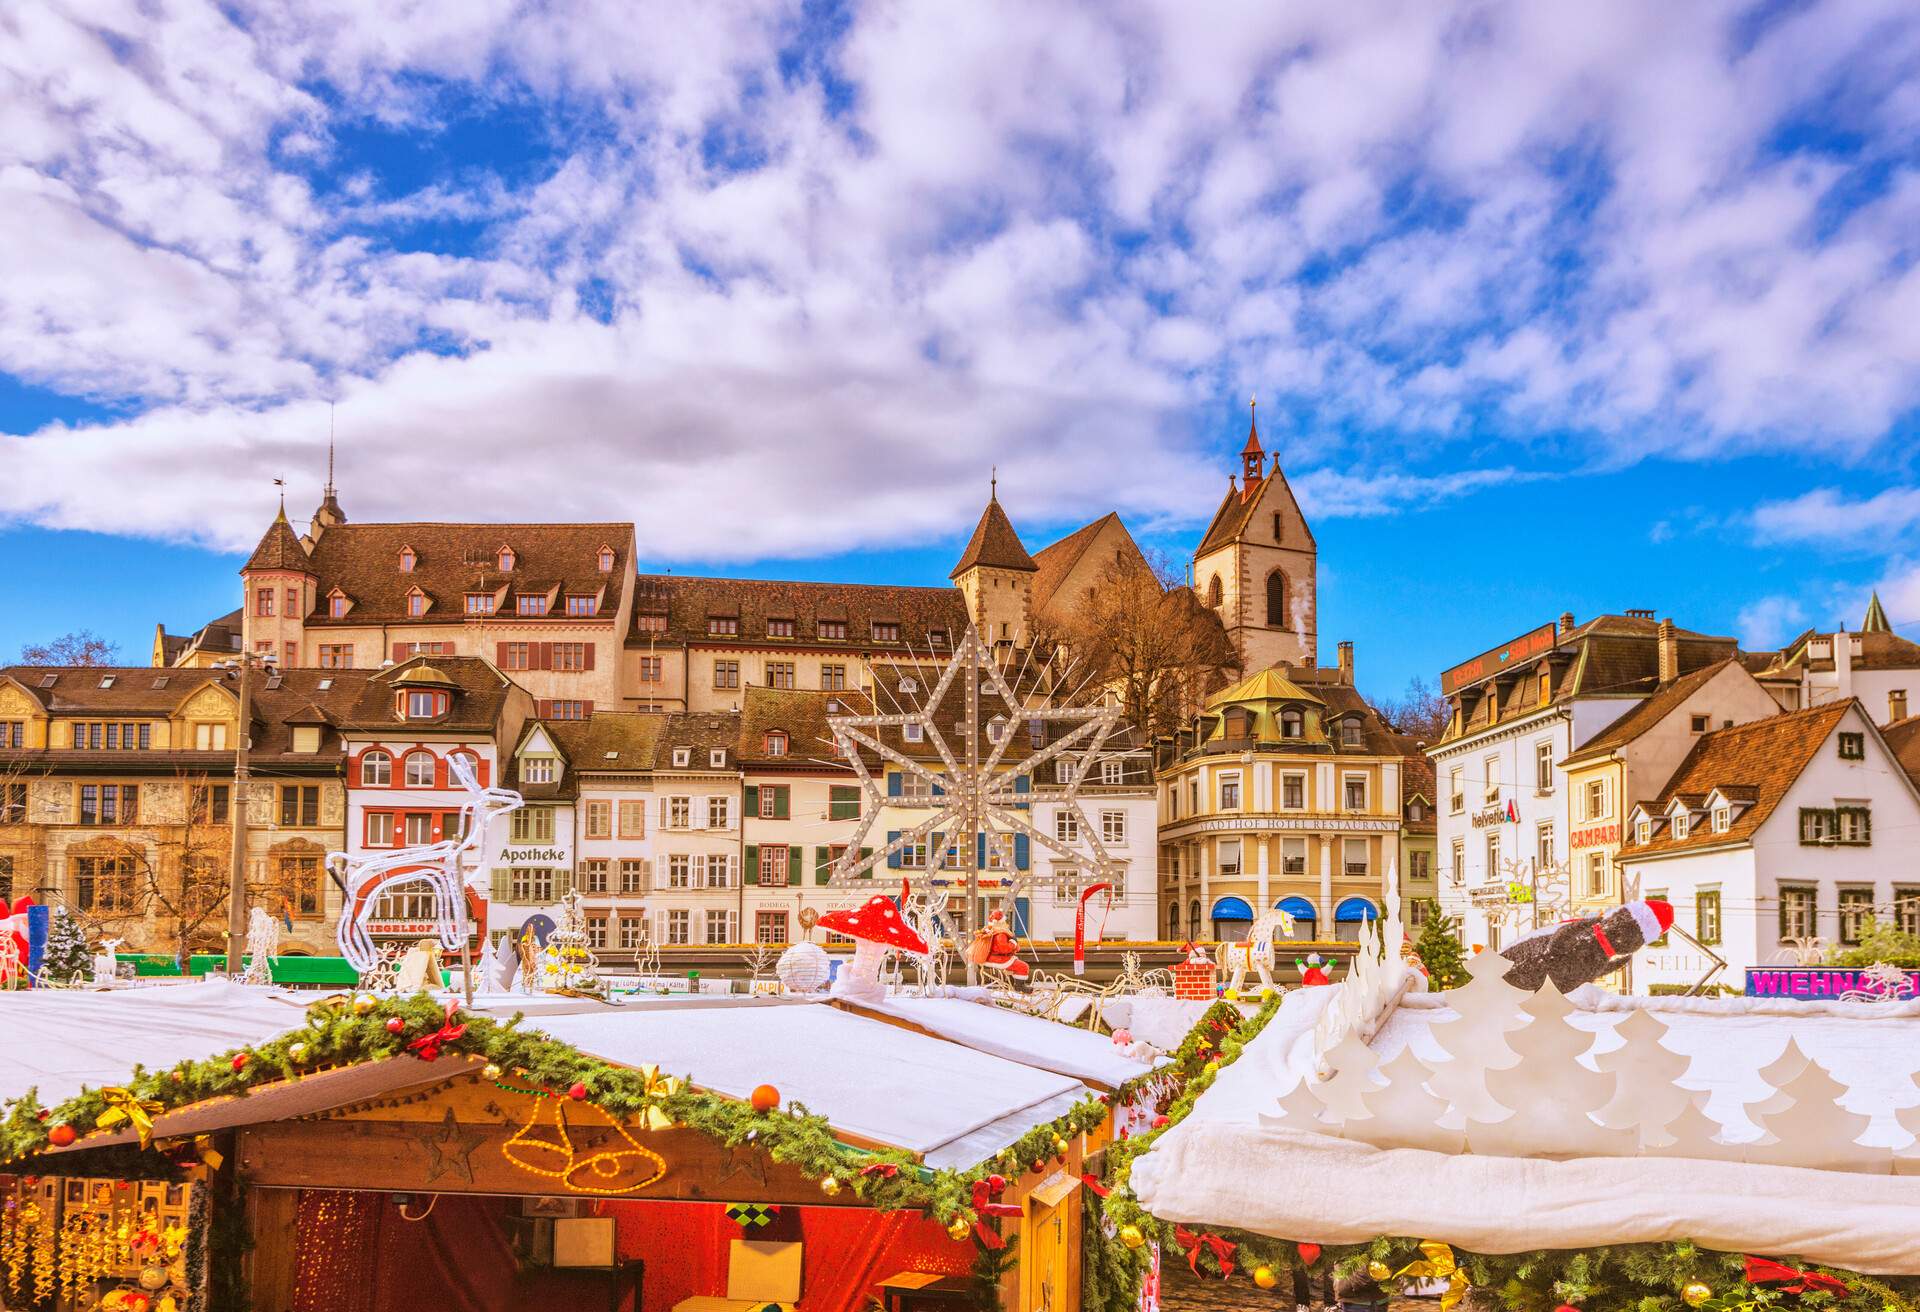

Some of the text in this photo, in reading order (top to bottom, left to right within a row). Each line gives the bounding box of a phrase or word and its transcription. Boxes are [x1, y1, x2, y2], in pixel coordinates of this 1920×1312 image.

[1200, 820, 1396, 831] STADTHOF HOTEL RESTAURANT
[1471, 808, 1505, 829] helvetia
[1571, 824, 1620, 848] CAMPARI
[499, 848, 565, 864] Apotheke
[1751, 972, 1920, 995] WIEHNA
